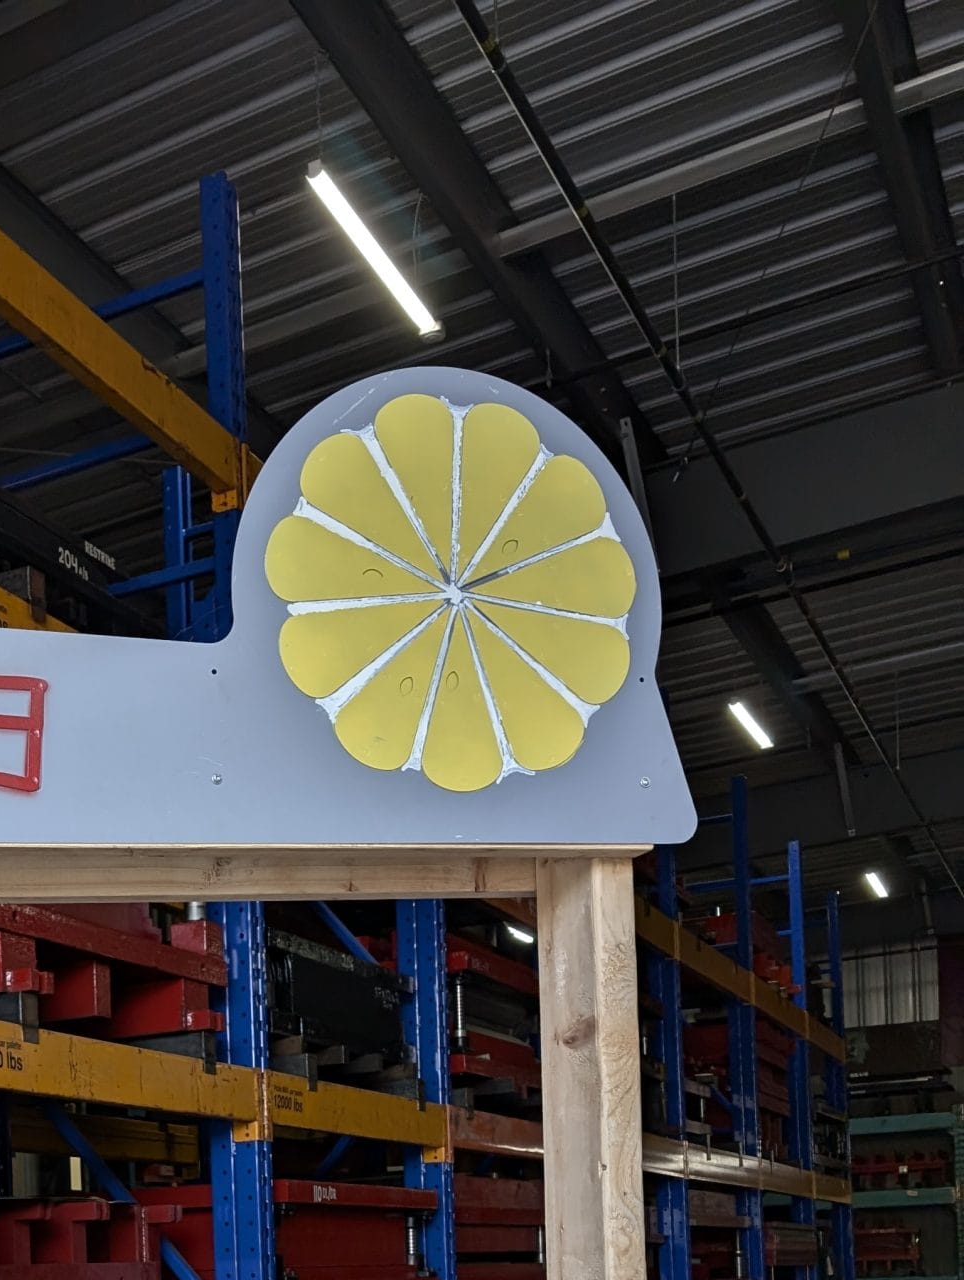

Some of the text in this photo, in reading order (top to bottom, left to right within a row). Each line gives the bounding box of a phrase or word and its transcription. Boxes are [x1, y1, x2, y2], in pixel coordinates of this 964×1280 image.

[6, 1050, 23, 1071] lbs
[274, 1094, 303, 1113] 12000 lbs
